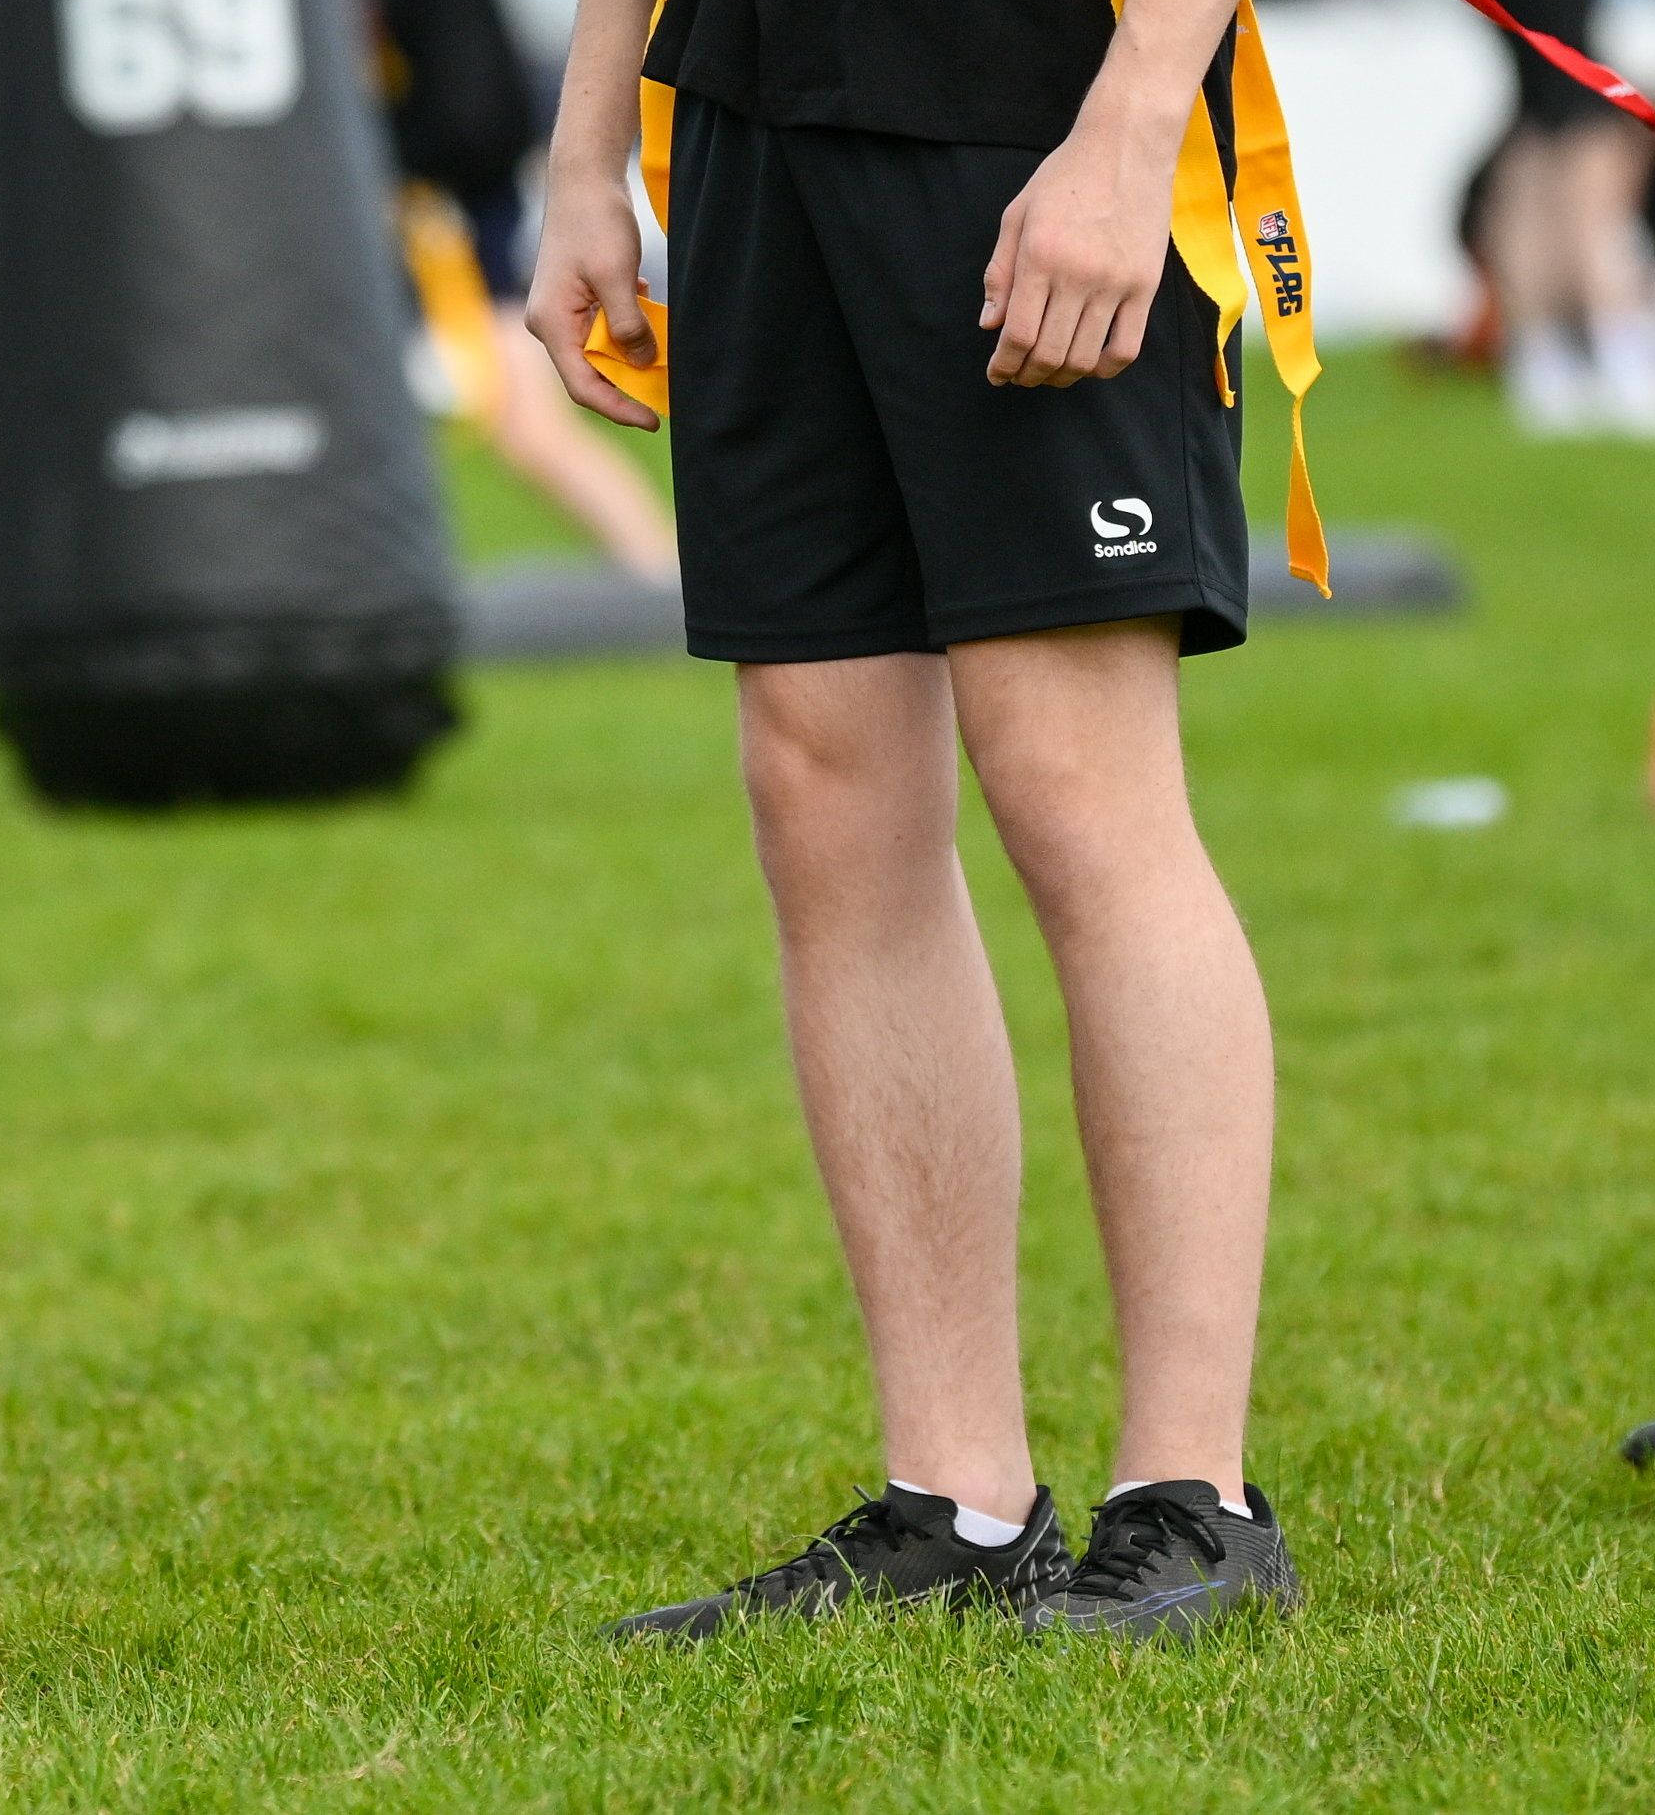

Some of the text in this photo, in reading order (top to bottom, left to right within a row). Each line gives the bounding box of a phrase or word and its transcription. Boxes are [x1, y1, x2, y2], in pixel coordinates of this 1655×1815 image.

[1256, 216, 1303, 317] NFL FLAG
[1094, 539, 1158, 559] Sondico
